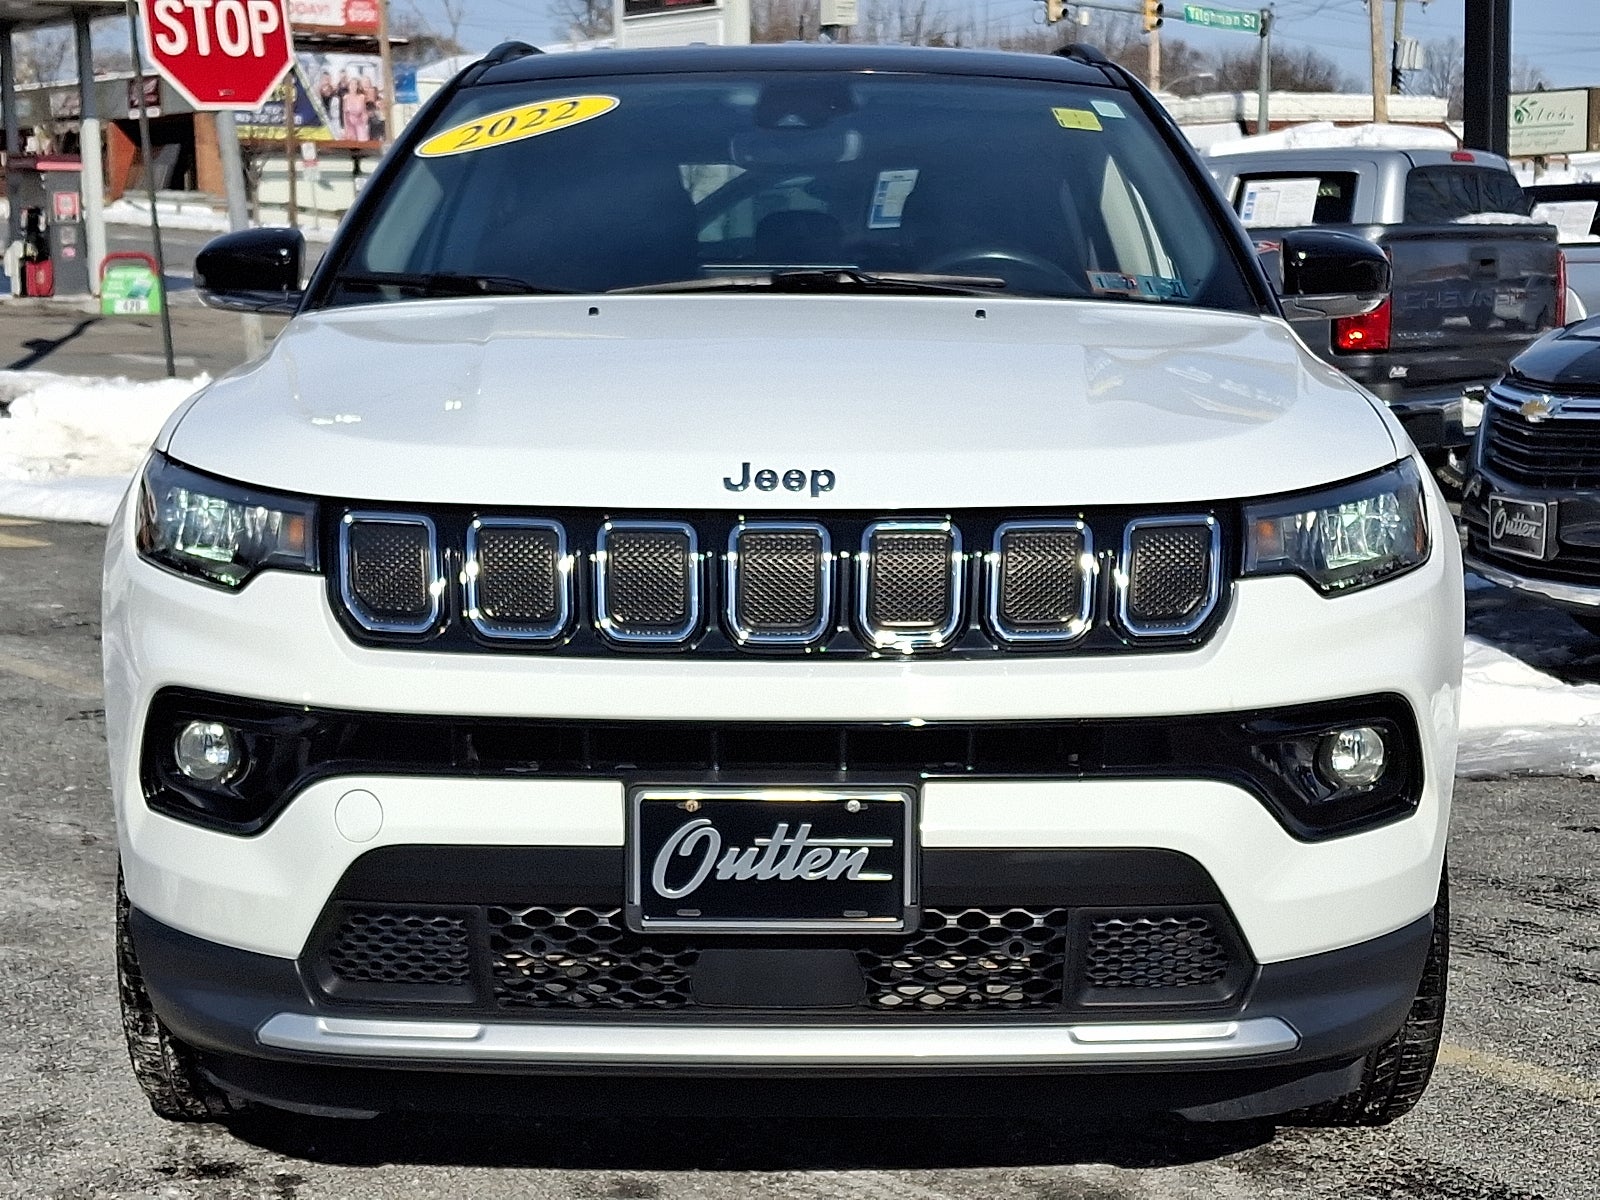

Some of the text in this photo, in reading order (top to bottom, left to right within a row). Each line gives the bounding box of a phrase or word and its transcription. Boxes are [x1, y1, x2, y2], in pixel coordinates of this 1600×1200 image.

[154, 0, 280, 58] STOP
[1187, 6, 1256, 28] Tilghman St
[453, 101, 579, 149] 2022
[723, 462, 836, 497] Jeep
[1493, 508, 1542, 539] Outten
[652, 818, 893, 899] Outten
